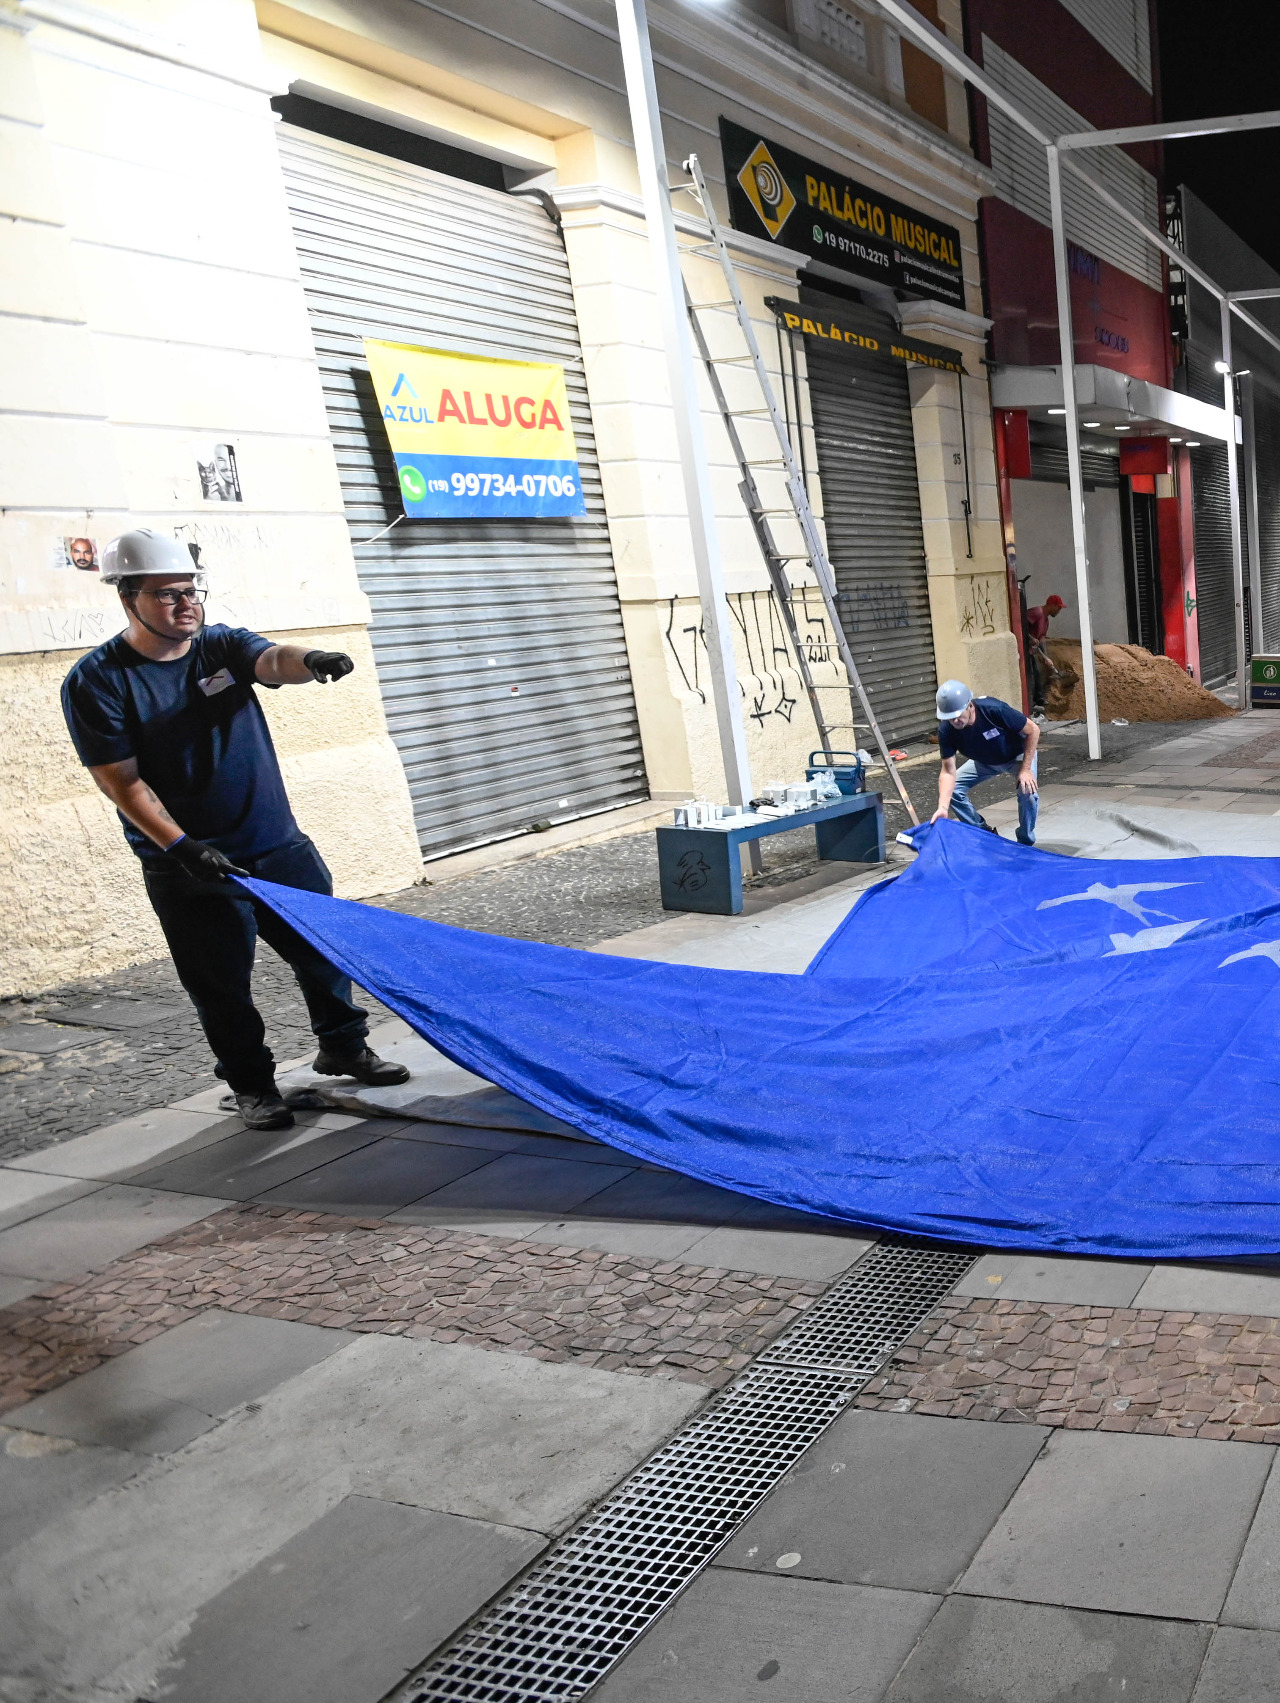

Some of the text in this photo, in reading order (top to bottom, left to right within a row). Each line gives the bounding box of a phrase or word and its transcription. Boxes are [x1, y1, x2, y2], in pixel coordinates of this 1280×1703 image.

[805, 174, 959, 268] PALÁCIO MUSICAL
[824, 231, 889, 268] 19 97170.2275
[783, 312, 963, 374] PALÁCIO MUSICAL
[383, 388, 565, 432] AZUL ALUGA
[428, 472, 576, 497] (19) 99734-0706
